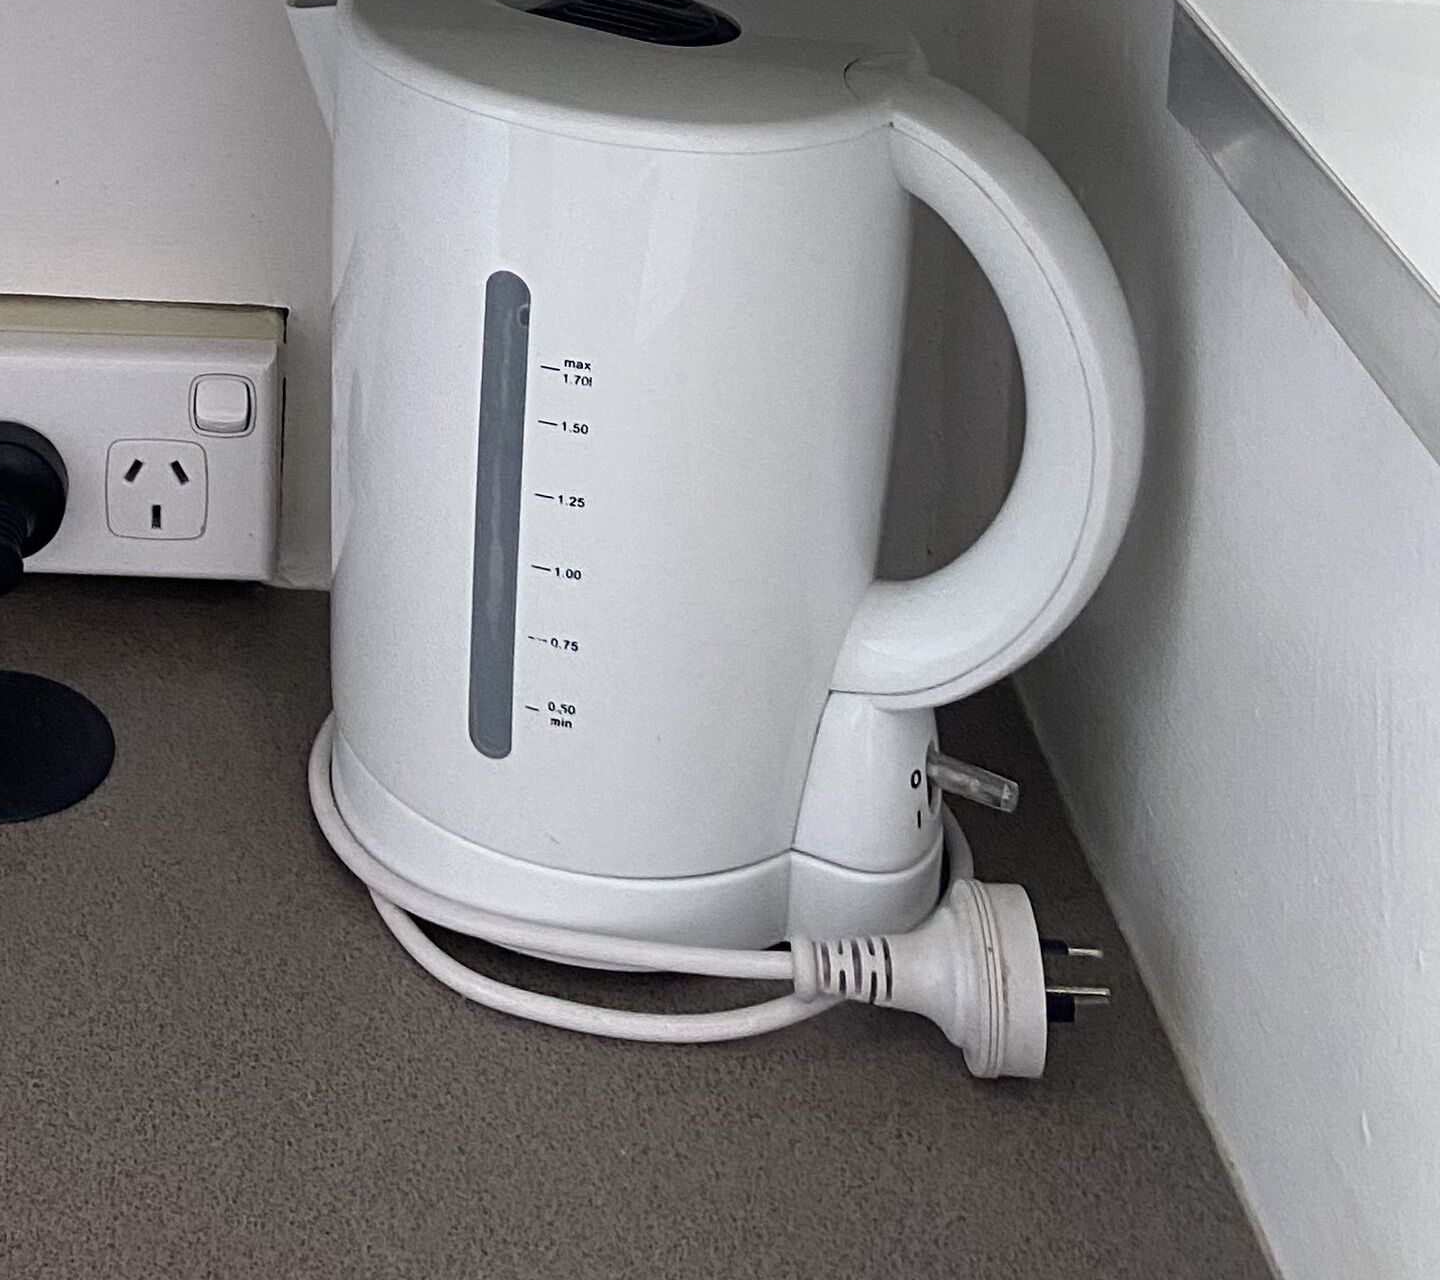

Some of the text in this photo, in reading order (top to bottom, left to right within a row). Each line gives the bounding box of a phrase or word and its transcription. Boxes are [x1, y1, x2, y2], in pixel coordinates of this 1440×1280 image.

[564, 359, 592, 371] max
[562, 421, 589, 435] 1.50
[558, 494, 586, 508] 1.25
[555, 567, 582, 580] 1.00
[550, 637, 579, 652] 0.75
[547, 701, 576, 715] 0.50
[550, 717, 573, 729] min
